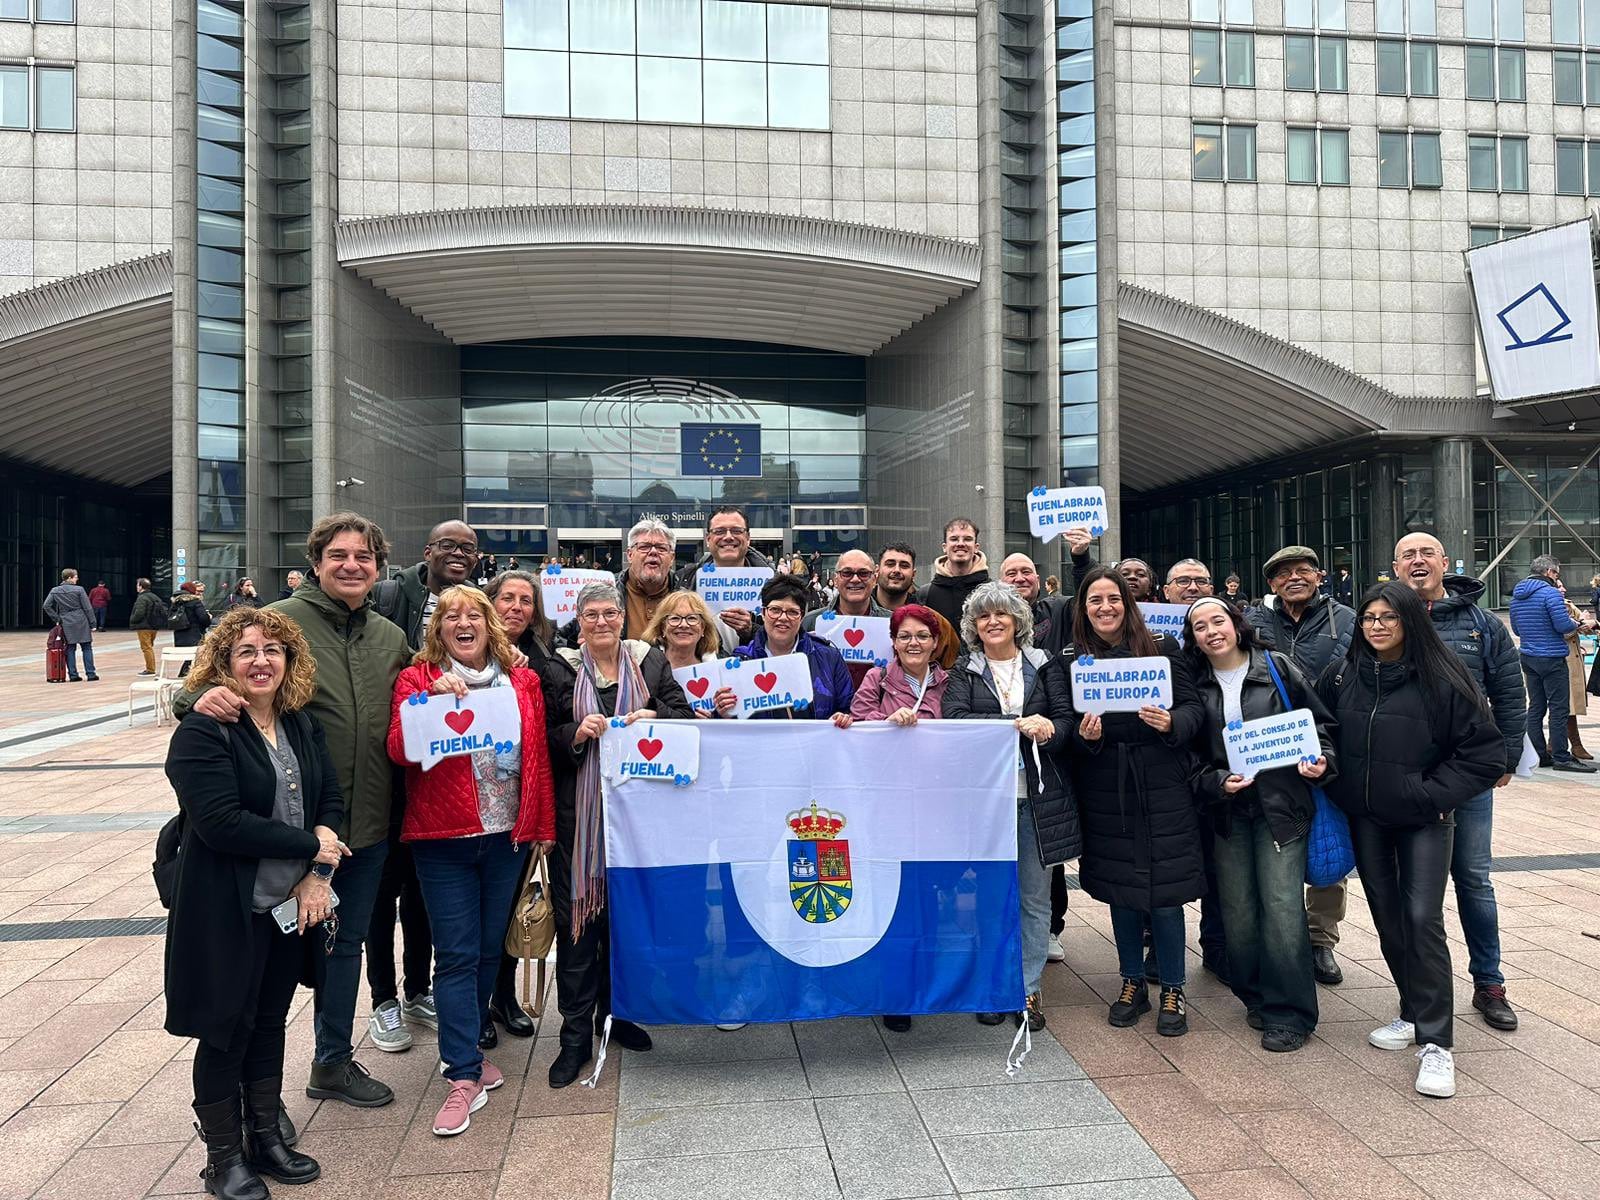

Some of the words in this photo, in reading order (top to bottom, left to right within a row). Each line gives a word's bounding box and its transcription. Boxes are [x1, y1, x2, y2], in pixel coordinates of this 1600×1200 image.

[1031, 497, 1103, 512] FUENLABRADA
[640, 512, 670, 521] Altiero
[671, 512, 705, 522] Spinelli
[1039, 514, 1054, 525] EN
[1058, 511, 1099, 523] EUROPA
[705, 592, 719, 601] EN
[557, 604, 568, 612] LA
[852, 618, 857, 628] I
[693, 667, 697, 678] I
[761, 661, 765, 672] I
[1075, 669, 1167, 683] FUENLABRADA
[1083, 688, 1101, 700] EN
[1105, 687, 1160, 699] EUROPA
[455, 698, 460, 709] I
[743, 692, 793, 710] FUENLA
[648, 725, 653, 738] I
[1229, 735, 1242, 743] SOY
[1245, 731, 1259, 739] DEL
[1262, 723, 1295, 735] CONSEJO
[1298, 719, 1308, 727] DE
[430, 733, 494, 755] FUENLA
[1238, 745, 1249, 754] LA
[1251, 736, 1291, 751] JUVENTUD
[1293, 733, 1304, 743] DE
[1246, 748, 1302, 765] FUENLABRADA
[620, 762, 674, 776] FUENLA
